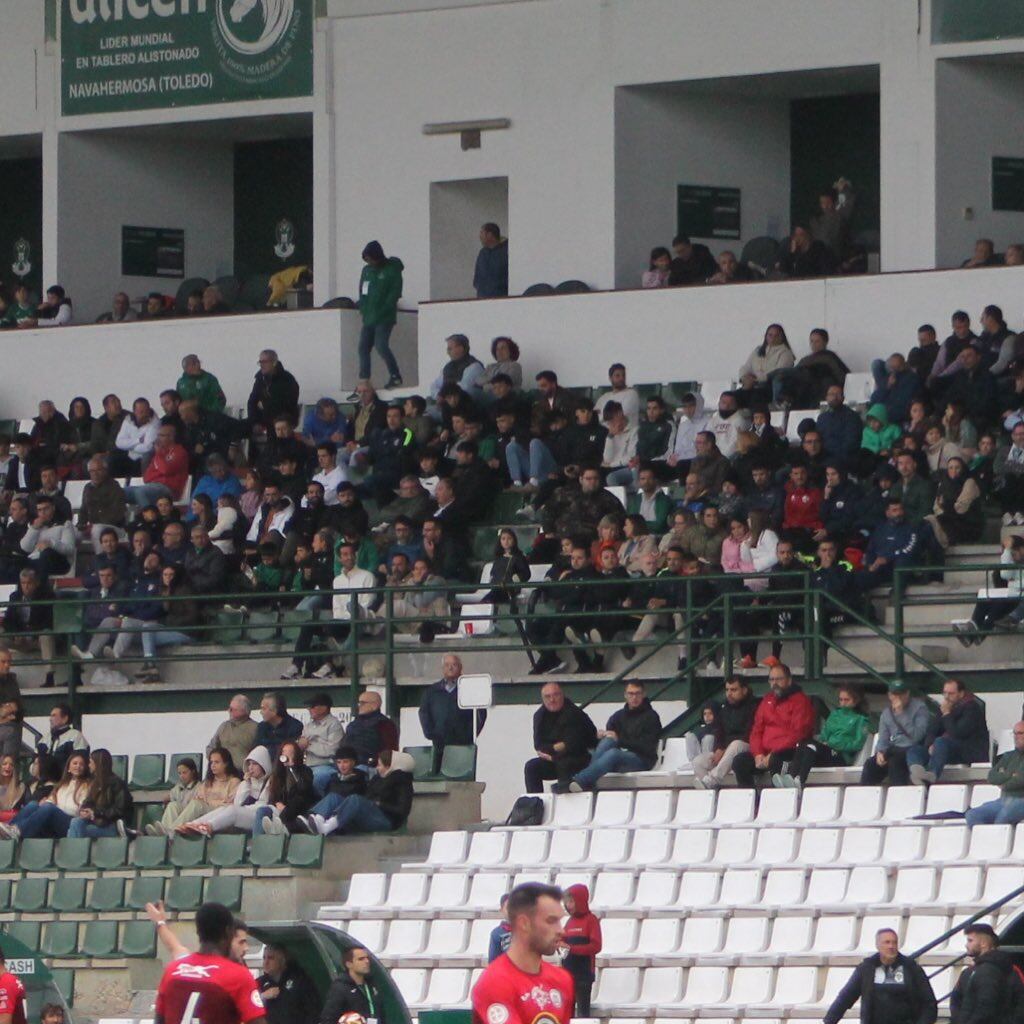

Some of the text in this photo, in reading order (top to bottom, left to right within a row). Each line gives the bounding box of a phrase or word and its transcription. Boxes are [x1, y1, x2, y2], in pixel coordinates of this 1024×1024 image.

[100, 32, 175, 49] LIDER MUNDIAL
[76, 47, 200, 69] EN TABLERO ALISTONADO
[69, 72, 213, 98] NAVAHERMOSA (TOLEDO)
